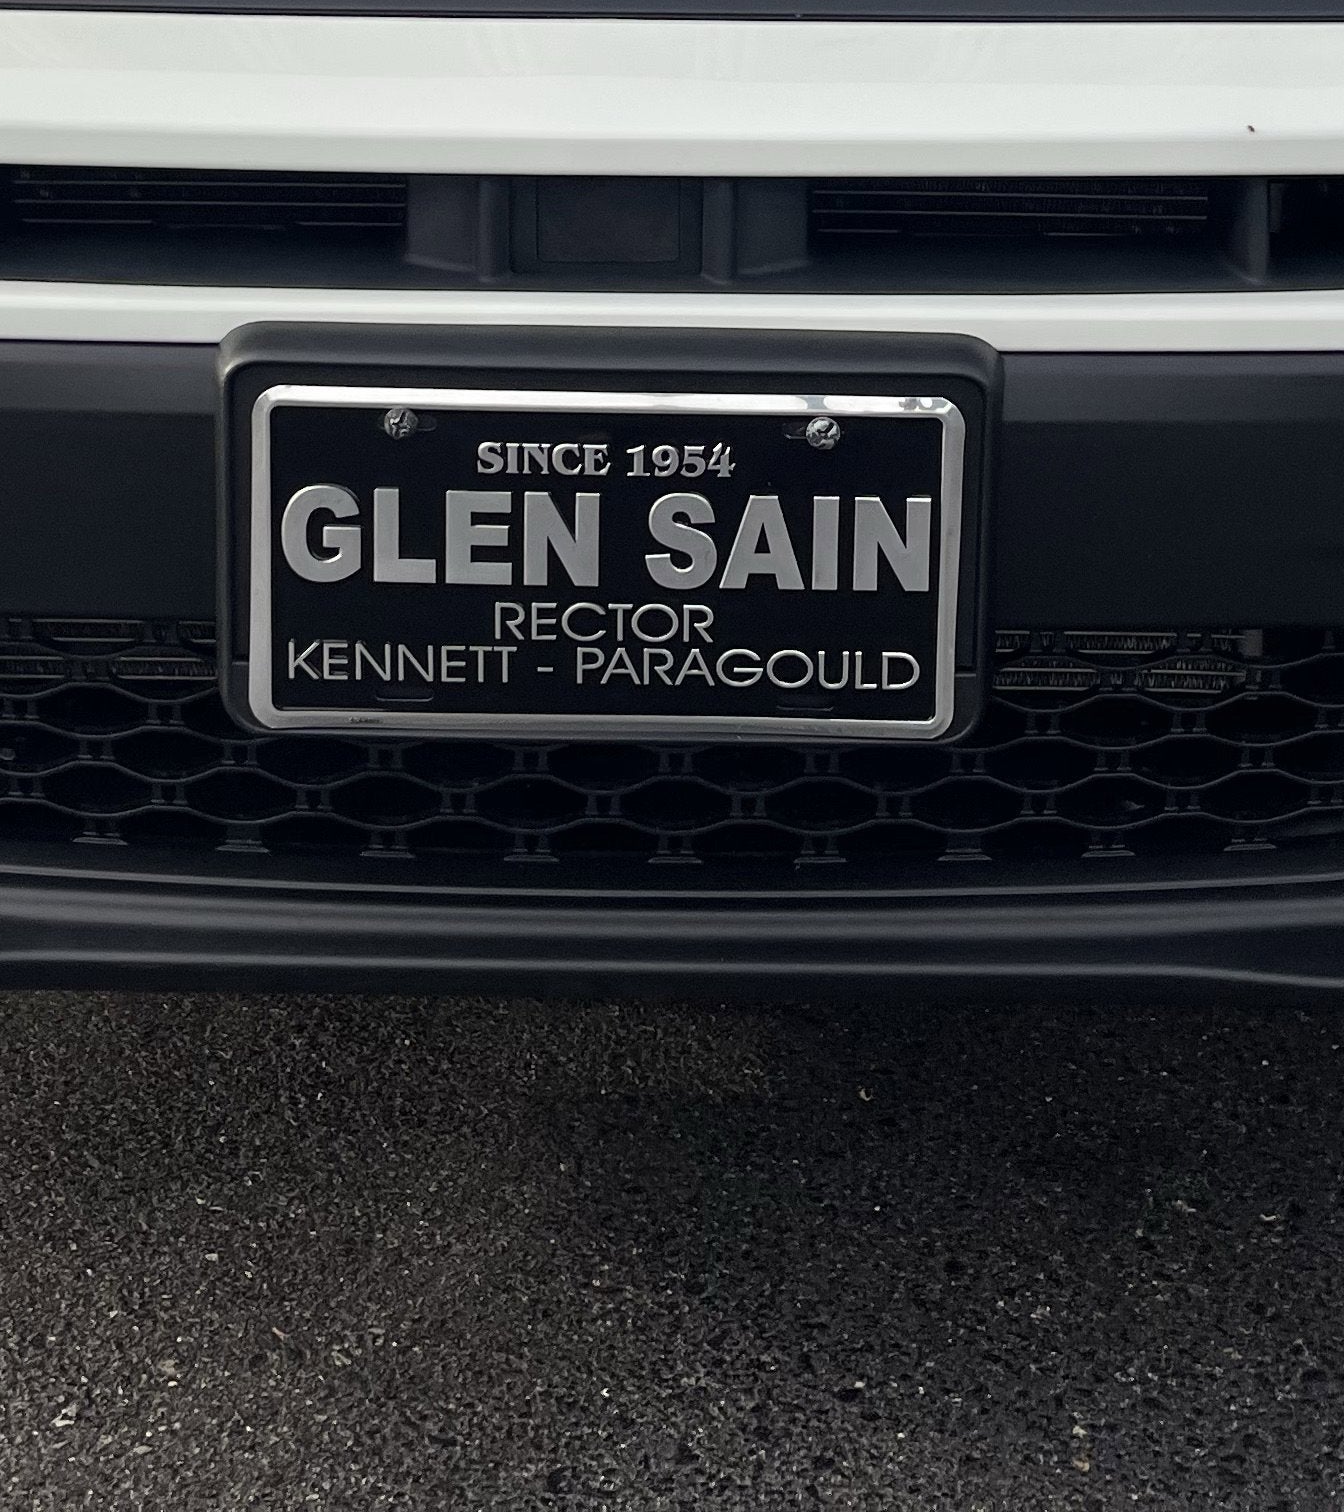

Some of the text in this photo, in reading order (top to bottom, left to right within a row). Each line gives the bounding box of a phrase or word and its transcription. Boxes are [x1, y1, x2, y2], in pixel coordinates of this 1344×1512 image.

[476, 441, 737, 479] SINCE 1954
[280, 484, 932, 592] GLEN SAIN
[493, 601, 715, 643] RECTOR
[287, 640, 518, 684] KENNETT
[576, 646, 921, 691] PARAGOULD
